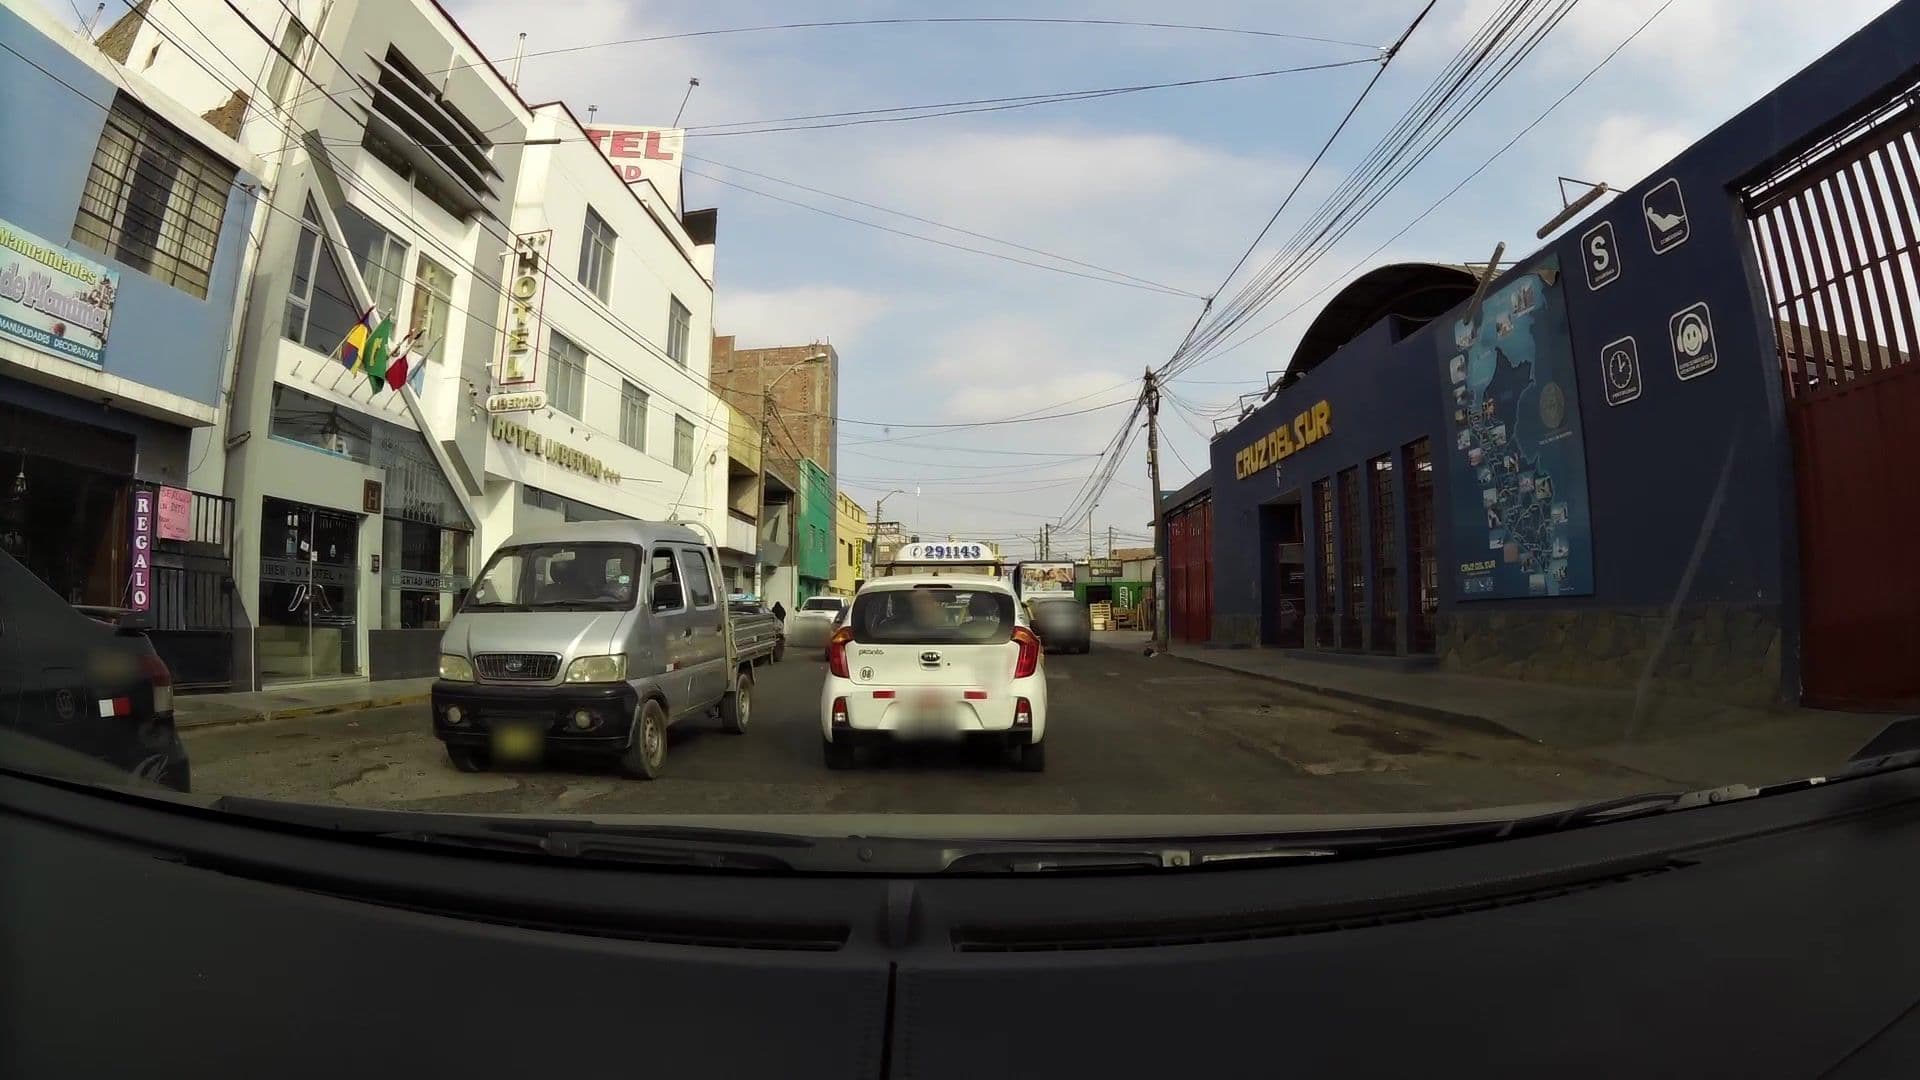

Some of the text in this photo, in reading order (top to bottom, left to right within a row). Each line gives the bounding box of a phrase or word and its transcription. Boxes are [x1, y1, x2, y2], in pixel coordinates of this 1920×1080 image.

[507, 252, 539, 380] HOTEL
[490, 396, 541, 411] LIBERTAD
[491, 415, 544, 457] HOTEL
[1235, 400, 1333, 480] CRUZ DEL SUR
[134, 498, 149, 611] REGALO
[924, 545, 981, 559] 291143
